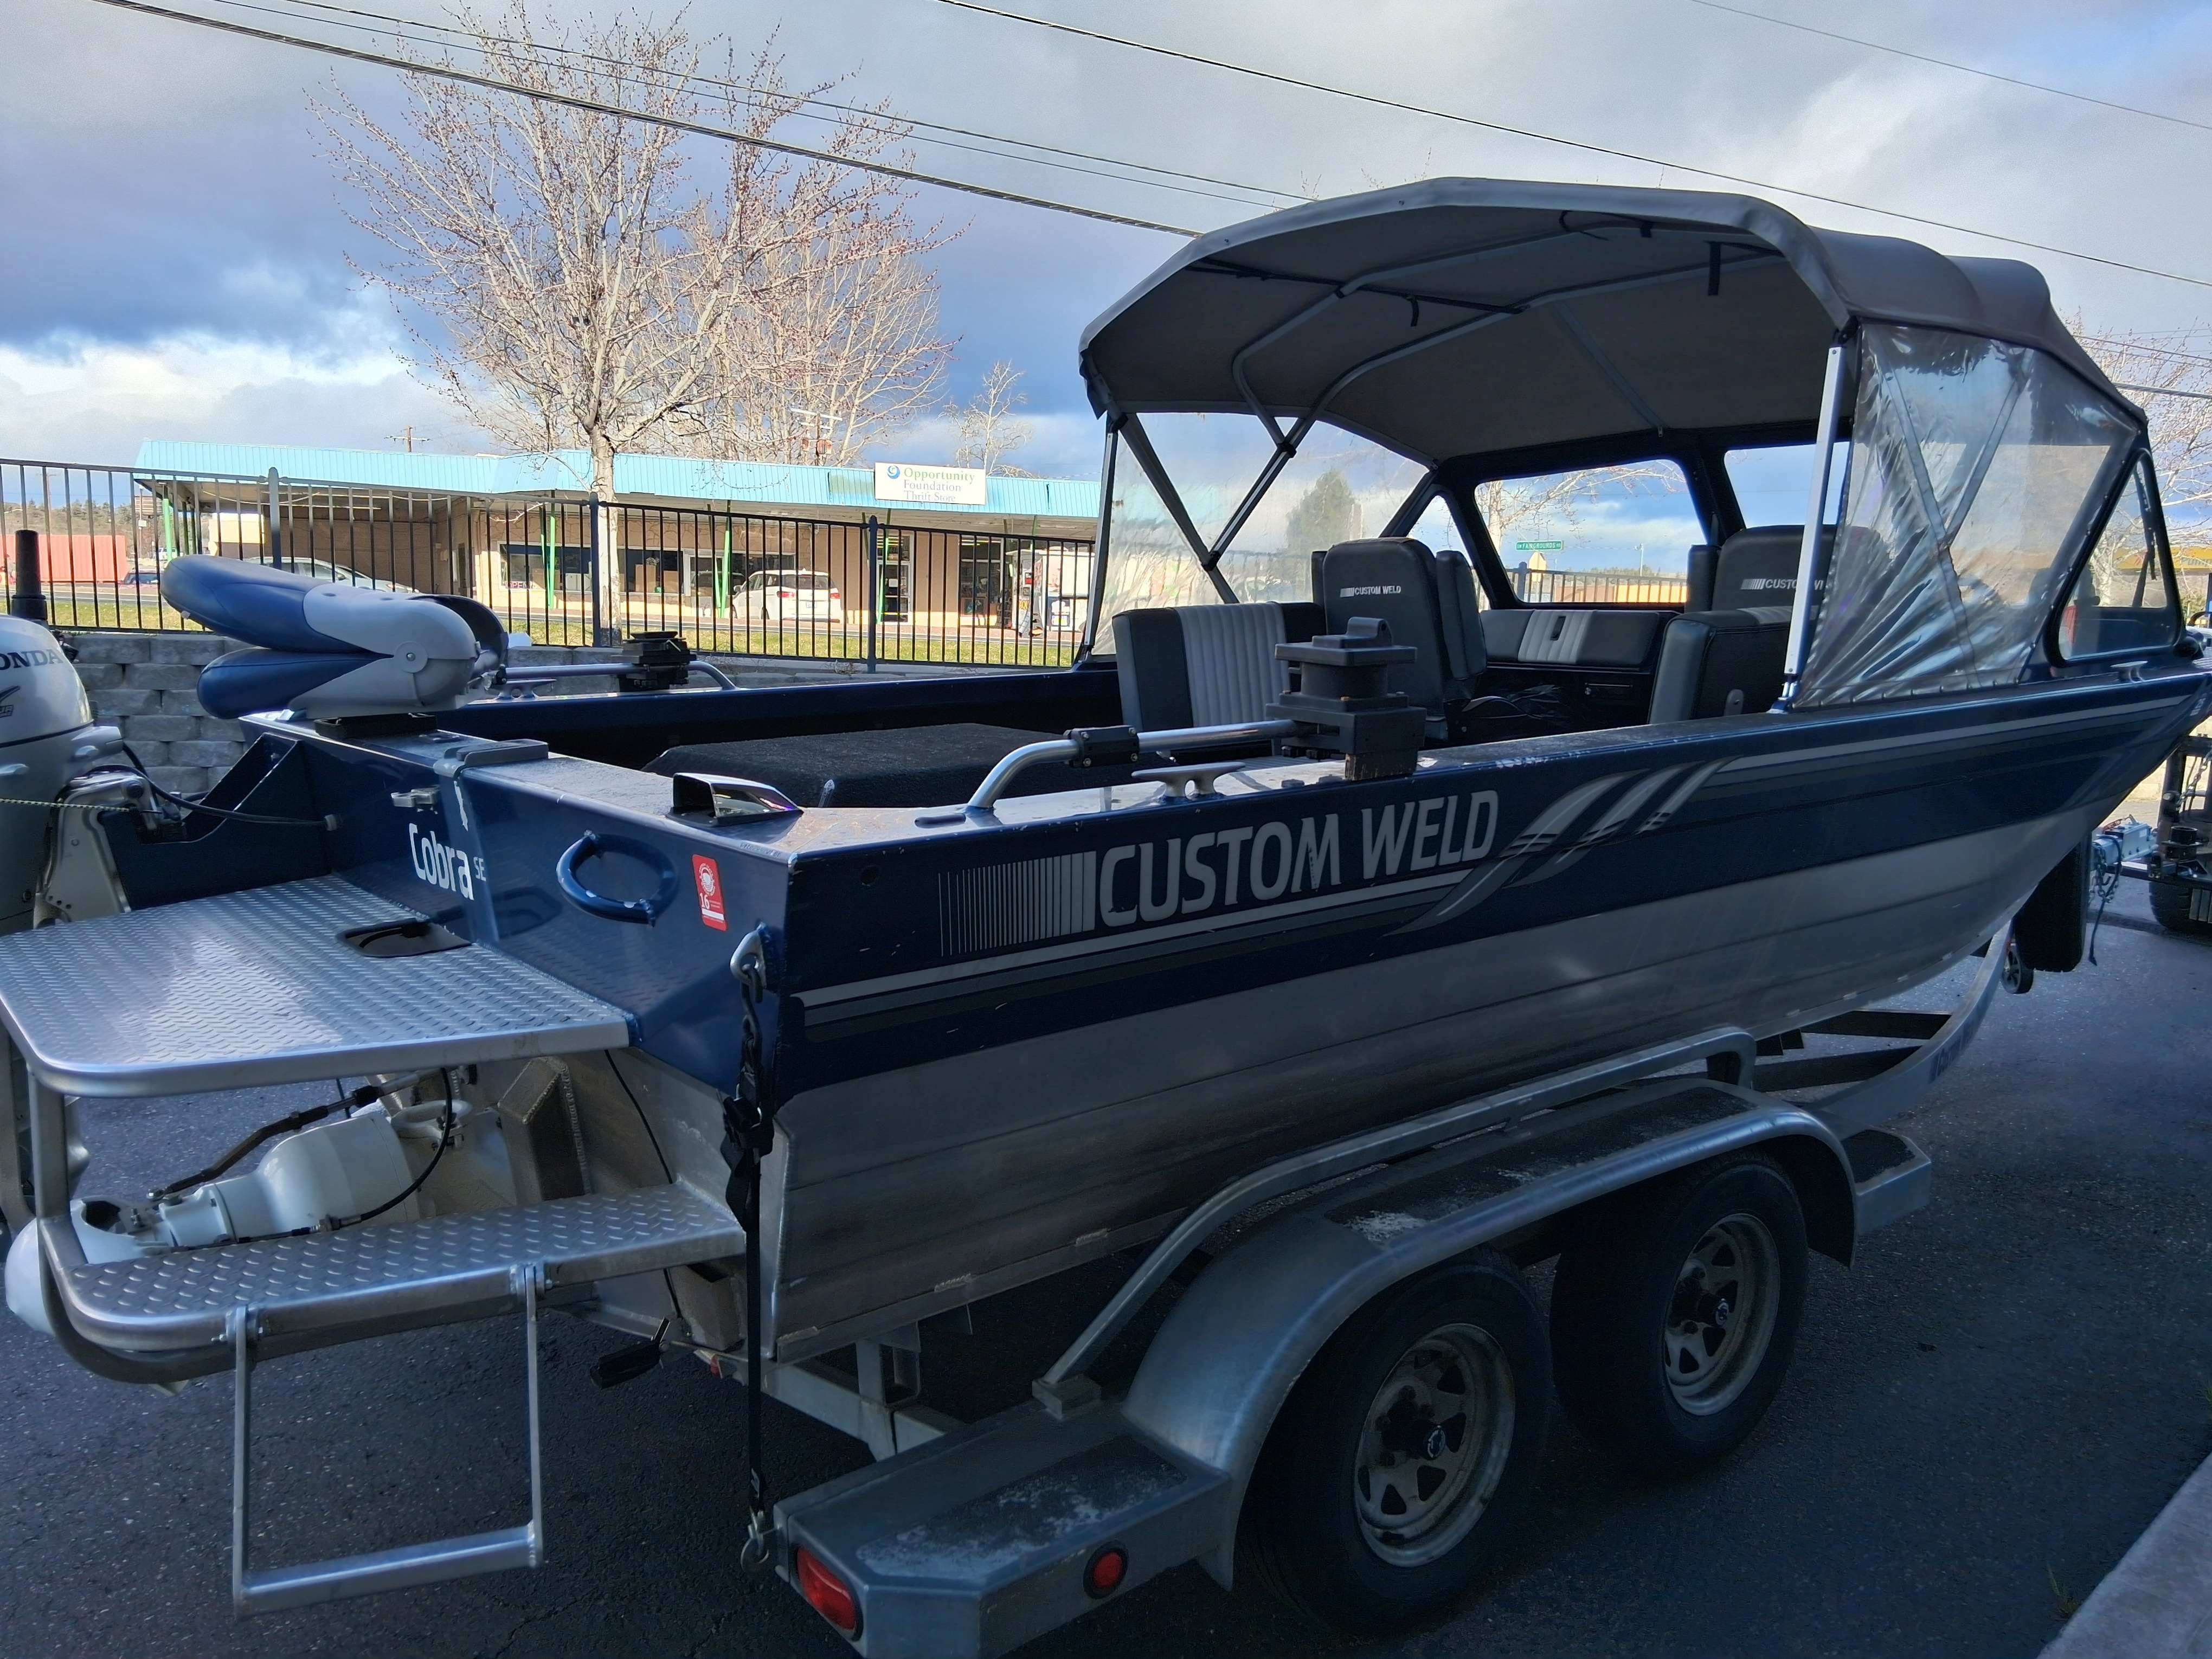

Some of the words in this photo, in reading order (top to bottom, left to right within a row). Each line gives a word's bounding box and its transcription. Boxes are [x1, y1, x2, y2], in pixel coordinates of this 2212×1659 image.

[904, 468, 975, 484] Opportunity
[904, 479, 961, 492] Foundation
[904, 490, 931, 501] Thrift
[934, 492, 956, 502] Store
[1354, 586, 1381, 595] CUSTOM
[1382, 586, 1401, 595] WELD
[1765, 579, 1798, 590] CUSTO
[0, 650, 63, 670] ONDA
[409, 823, 474, 901] Cobra
[473, 857, 486, 882] SE
[1100, 814, 1342, 927] CUSTOM
[1361, 790, 1499, 879] WELD
[699, 892, 710, 915] 16
